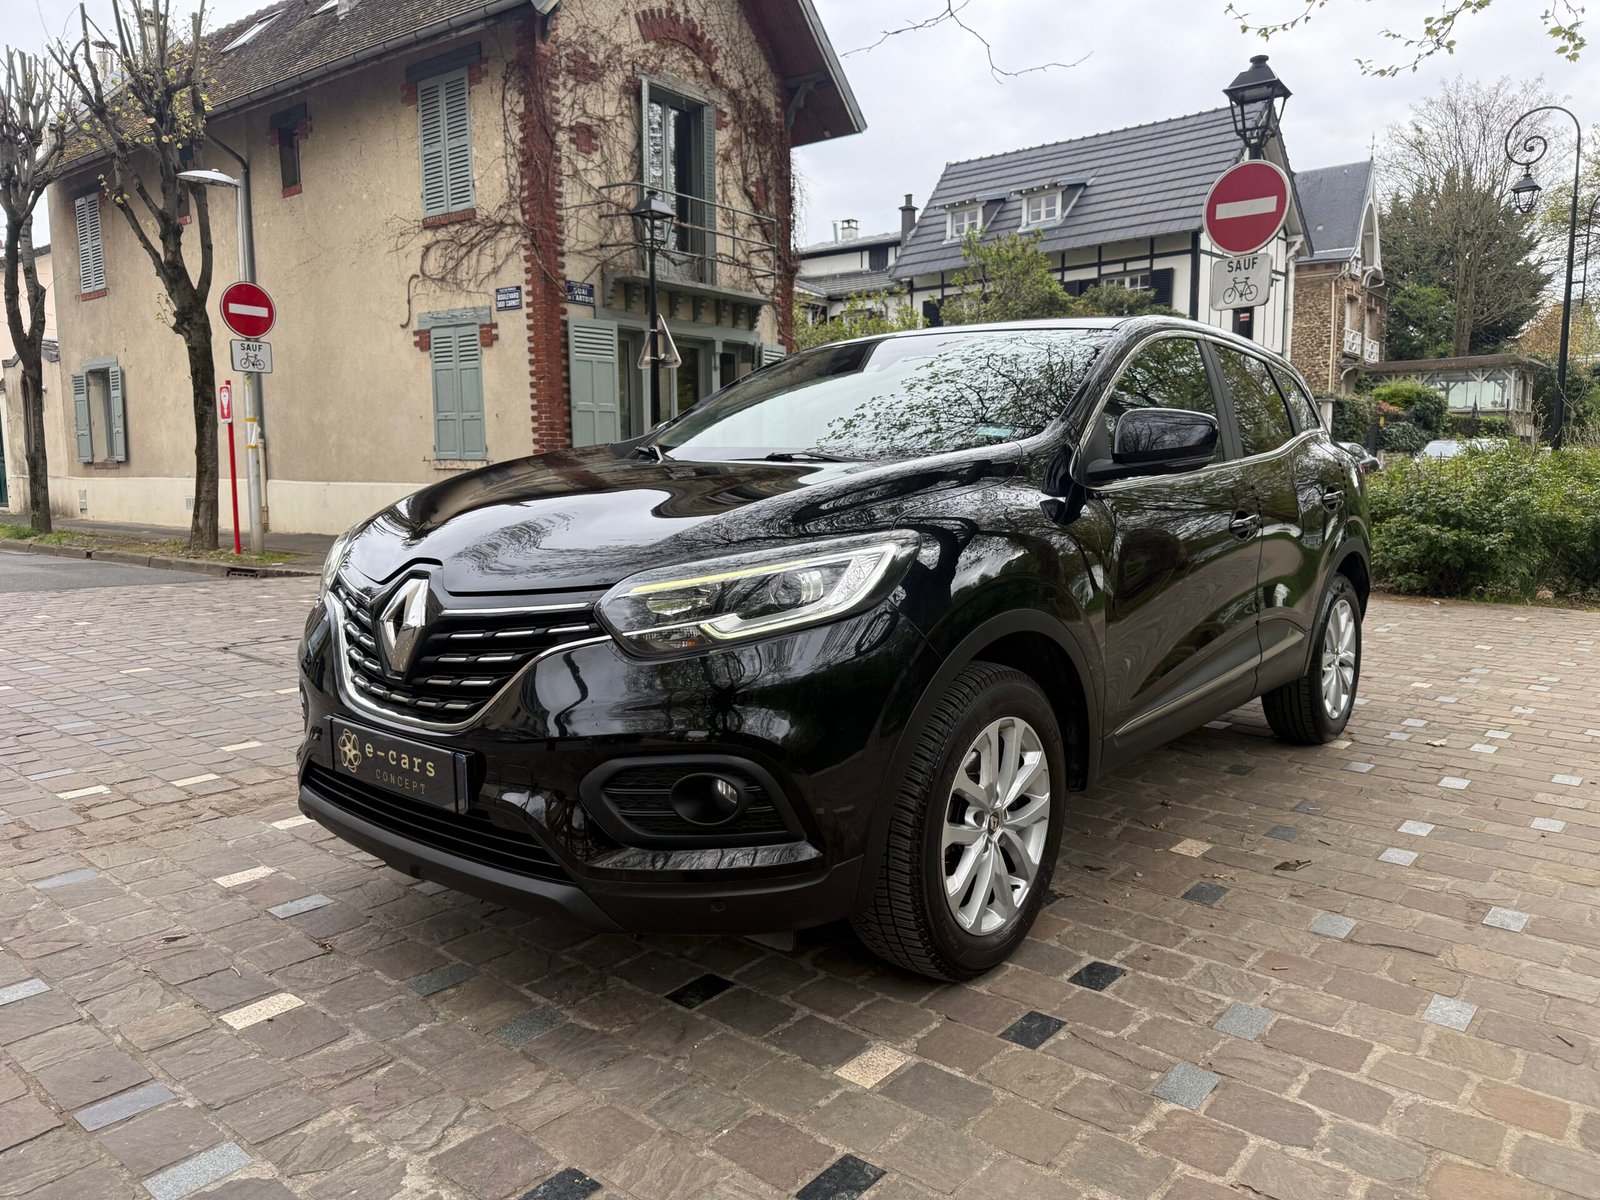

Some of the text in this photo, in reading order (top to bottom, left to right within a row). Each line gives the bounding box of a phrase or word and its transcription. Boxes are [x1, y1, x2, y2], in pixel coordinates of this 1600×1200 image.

[1227, 257, 1258, 273] SAUF
[497, 292, 519, 301] BOULEVARD
[240, 343, 262, 352] SAUF
[365, 743, 436, 777] e-cars
[375, 769, 426, 795] CONCEPT
